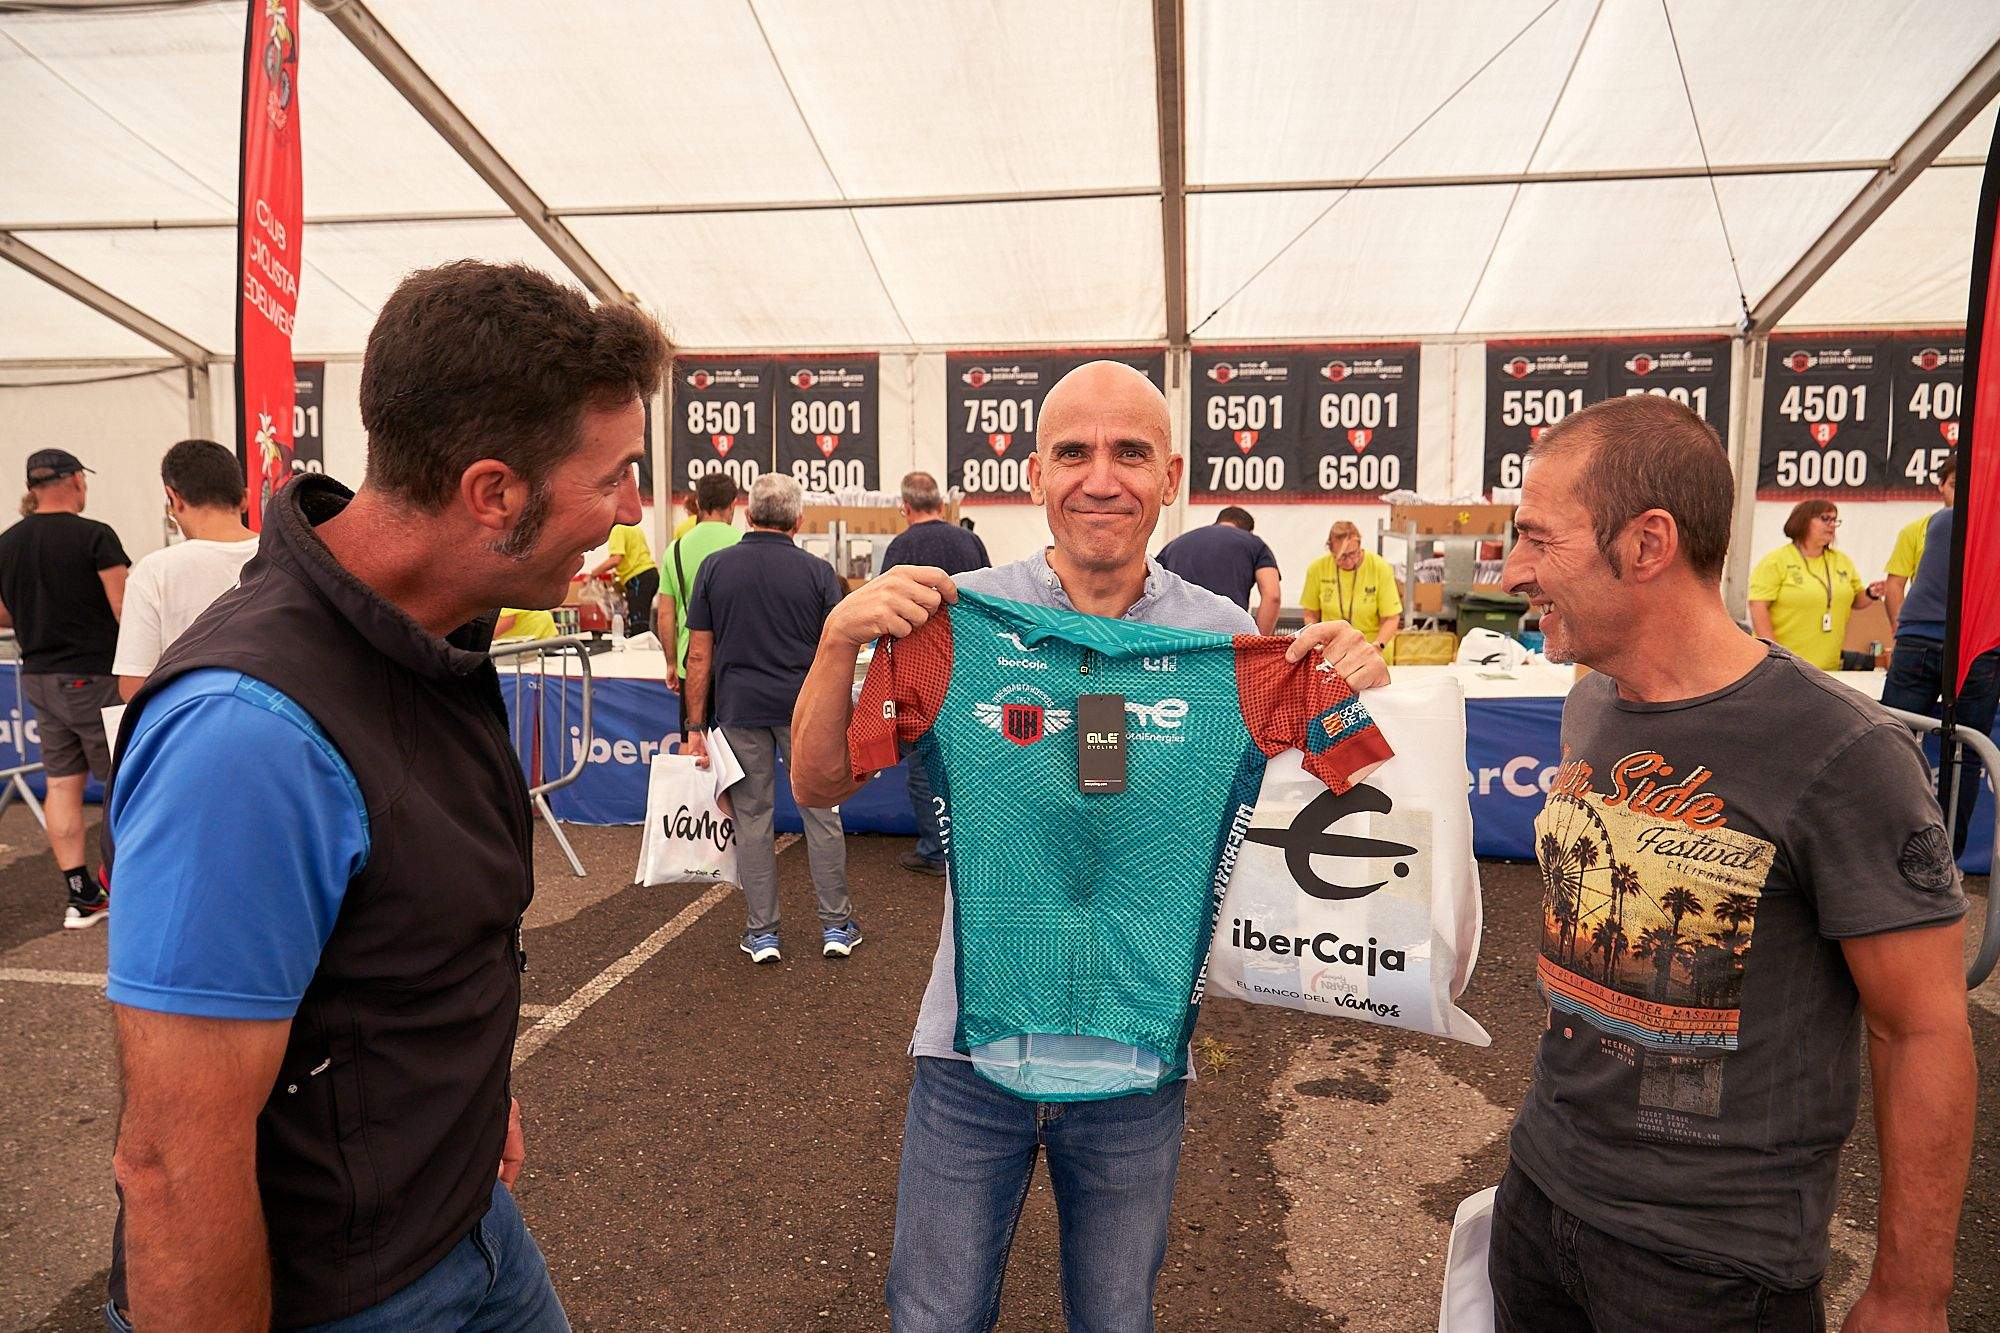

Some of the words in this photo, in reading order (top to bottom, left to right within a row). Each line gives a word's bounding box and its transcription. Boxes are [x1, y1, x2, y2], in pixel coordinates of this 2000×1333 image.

[255, 198, 287, 251] CLUB
[687, 400, 756, 435] 8501
[790, 400, 861, 435] 8001
[964, 399, 1034, 434] 7501
[1206, 394, 1283, 431] 6501
[1319, 392, 1398, 429] 6001
[1502, 388, 1583, 427] 5501
[1779, 384, 1867, 423] 4501
[791, 459, 865, 492] 8500
[1207, 455, 1285, 491] 7000
[1318, 454, 1400, 491] 6500
[1776, 449, 1867, 488] 5000
[1905, 448, 1957, 486] 45
[1603, 750, 1728, 829] Side
[1637, 827, 1764, 871] Festival
[1232, 918, 1406, 977] iberCaja
[1236, 980, 1250, 991] EL
[1254, 985, 1300, 999] BANCO
[1304, 993, 1329, 1004] DEL
[1610, 993, 1662, 1015] ANOTHER
[1672, 1009, 1732, 1020] MASSIVE
